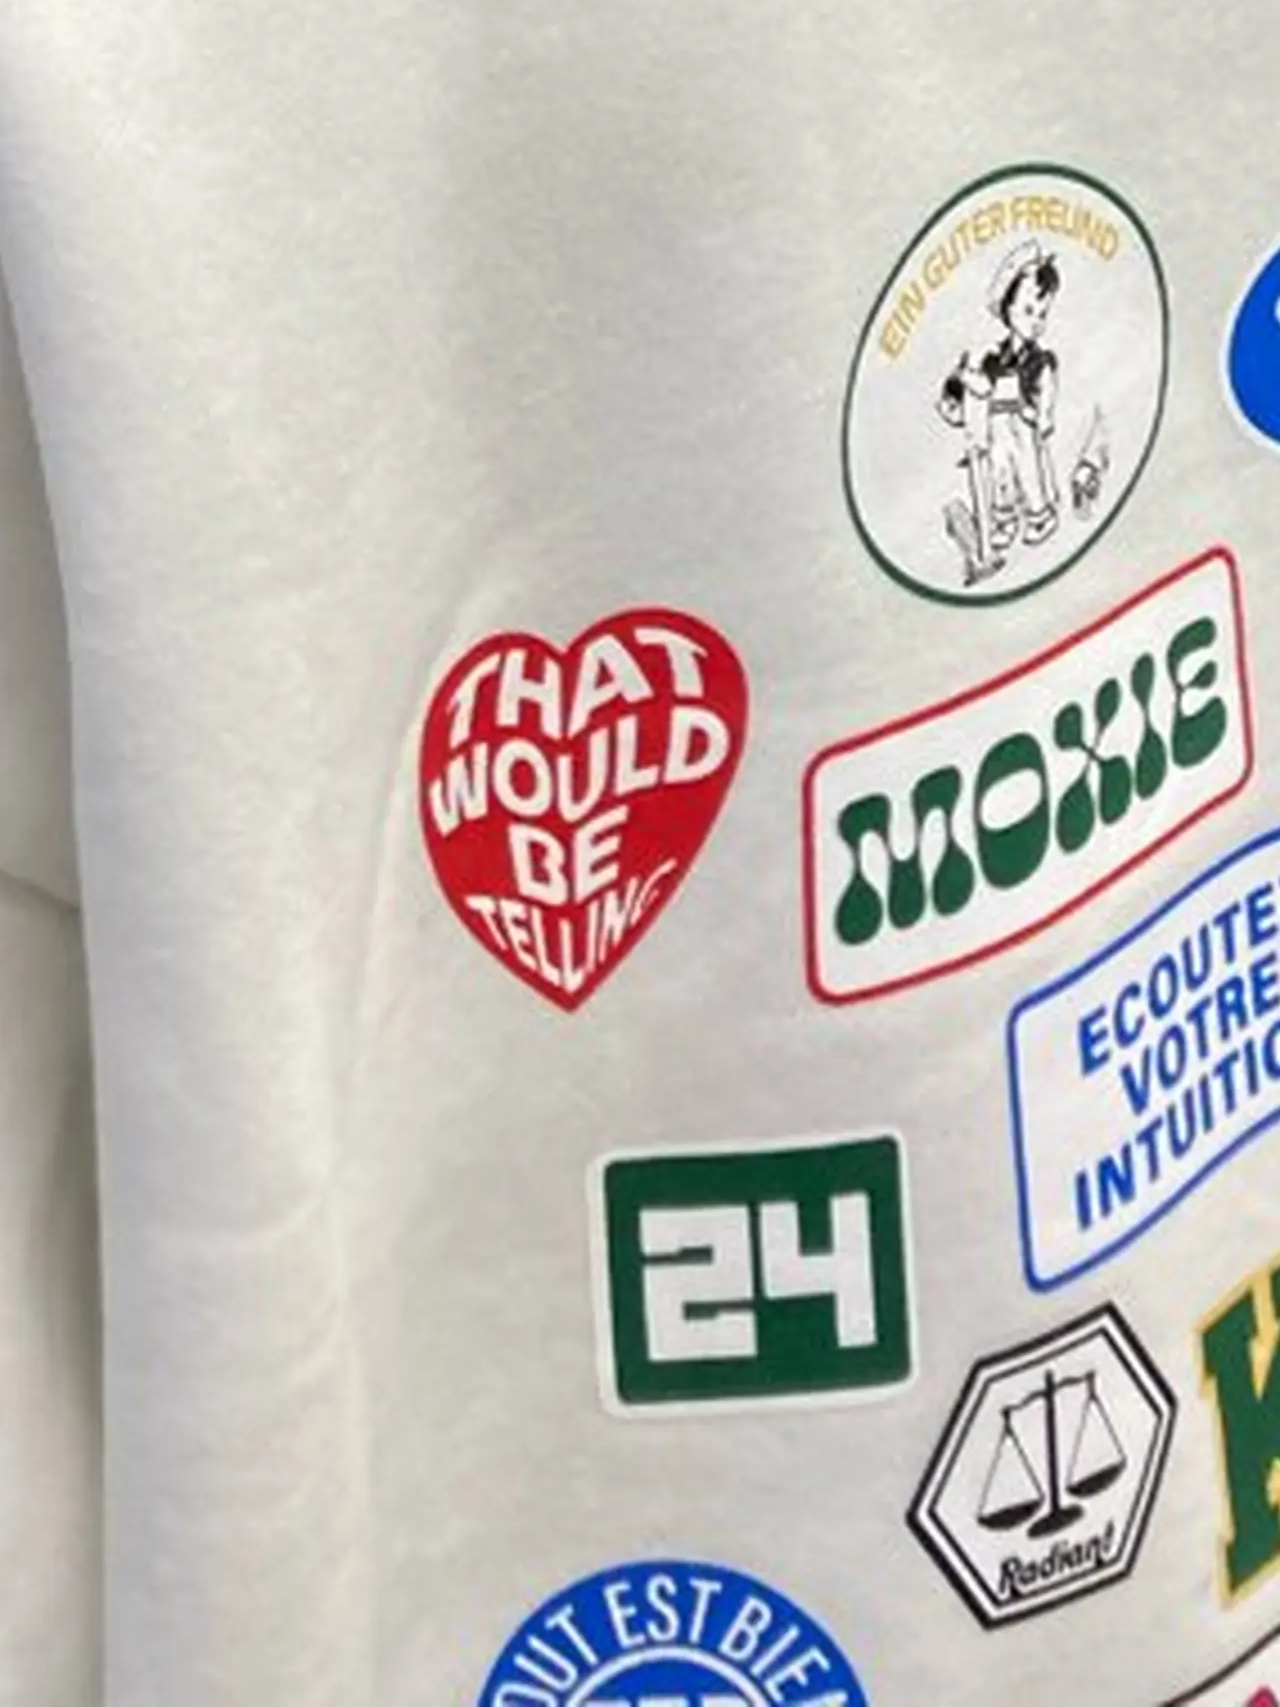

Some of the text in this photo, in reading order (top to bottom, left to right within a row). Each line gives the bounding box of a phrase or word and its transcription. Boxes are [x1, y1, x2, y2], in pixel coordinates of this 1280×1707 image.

[879, 196, 1120, 358] EIN GUTER FREUND
[446, 627, 708, 749] THAT
[429, 706, 730, 838] WOULD
[835, 616, 1227, 947] MOXIE
[507, 804, 629, 907] BE
[465, 859, 677, 993] TELLING
[639, 1191, 877, 1362] 24
[603, 1574, 722, 1648] EST
[998, 1517, 1115, 1597] Radiant
